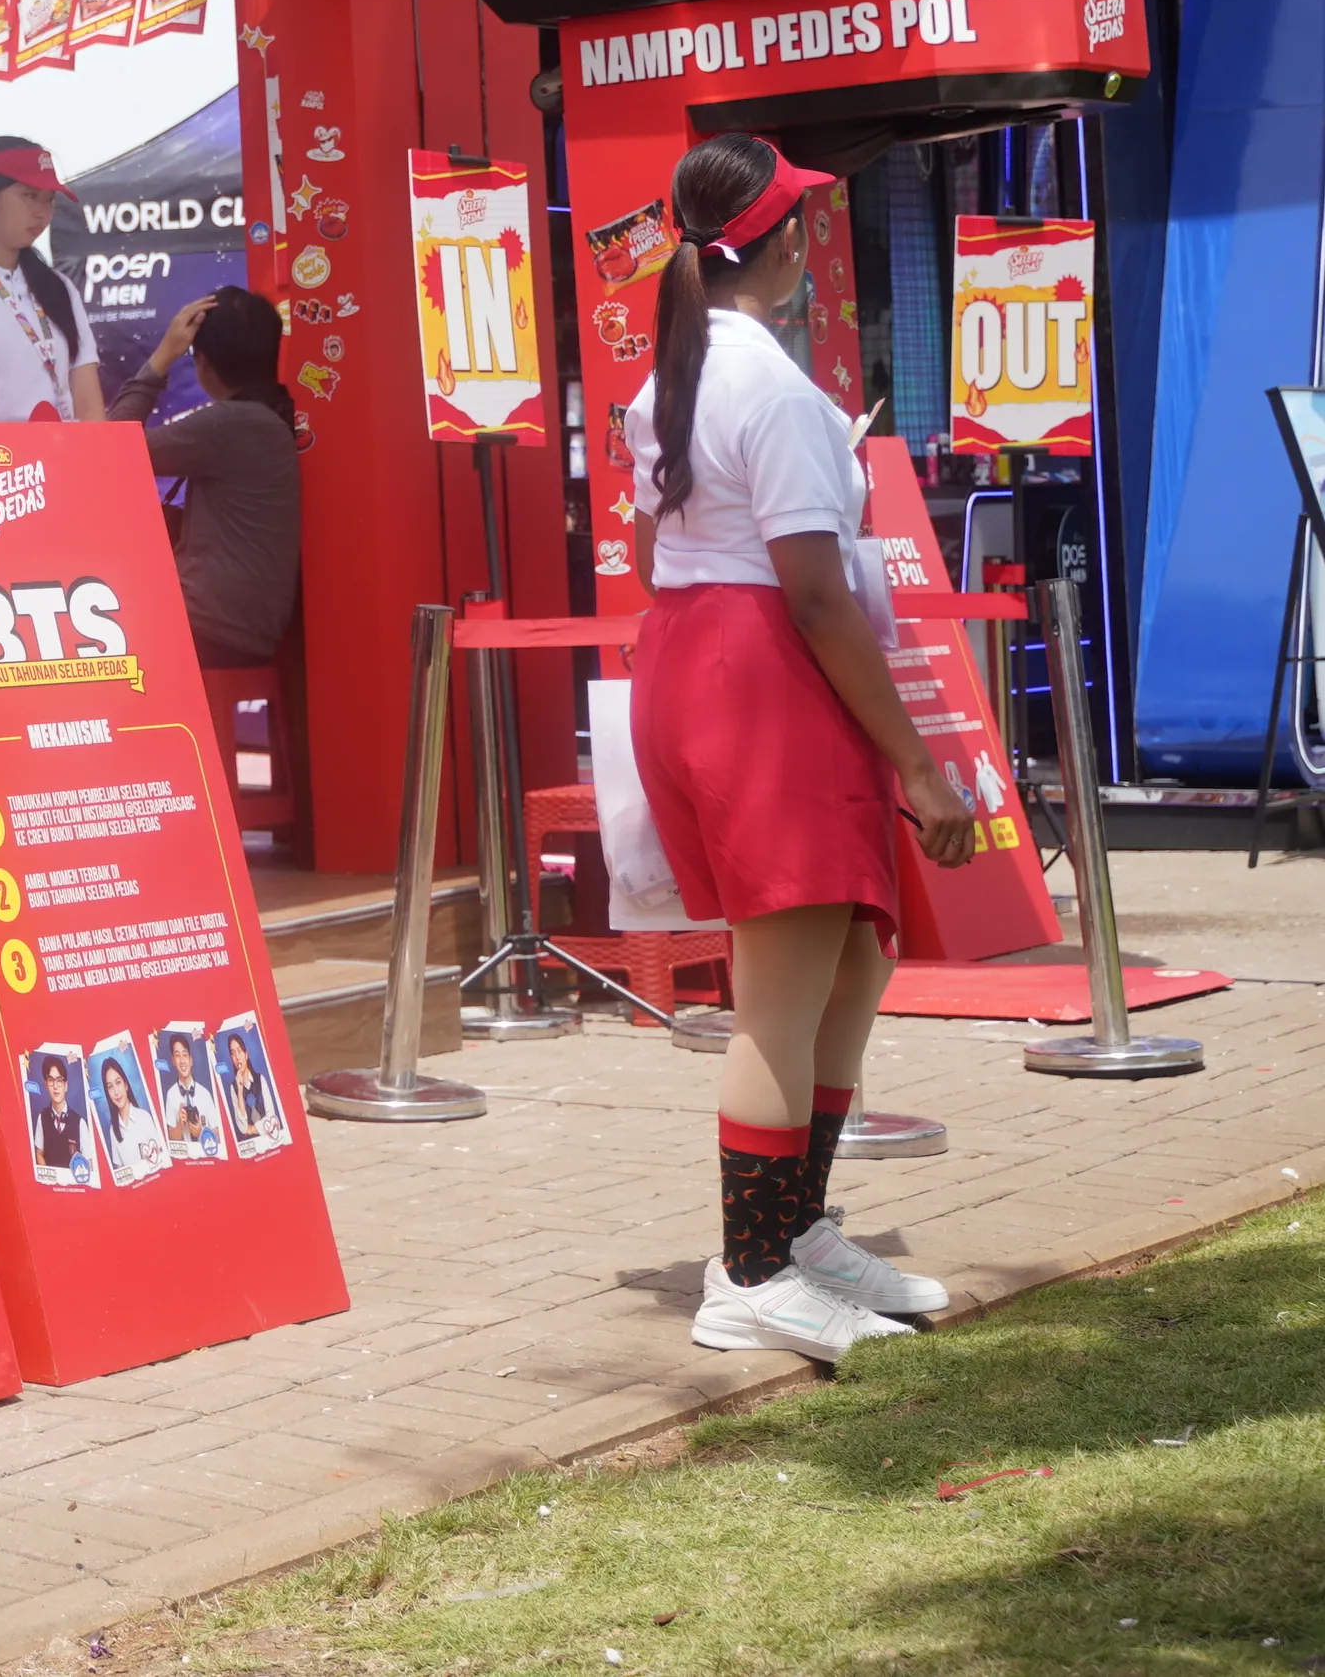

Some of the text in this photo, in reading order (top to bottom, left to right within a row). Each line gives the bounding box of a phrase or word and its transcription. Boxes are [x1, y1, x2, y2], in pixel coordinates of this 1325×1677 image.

[580, 20, 744, 87] NAMPOL
[750, 1, 883, 67] PEDES
[1088, 15, 1124, 53] PEDAS
[83, 198, 204, 234] WORLD
[629, 230, 666, 260] NAMPOL
[84, 251, 171, 304] posn
[101, 283, 147, 307] MEN
[439, 244, 518, 372] IN
[960, 300, 1087, 391] OUT
[899, 563, 929, 586] POL
[9, 664, 58, 682] TAHUNAN
[58, 662, 96, 680] SELERA
[98, 660, 128, 677] PEDAS
[26, 719, 113, 750] MEKANISME
[52, 790, 78, 807] KUPON
[120, 783, 148, 800] SELERA
[147, 781, 172, 797] PEDAS
[27, 827, 50, 845] CREW
[49, 825, 74, 842] BUKU
[73, 821, 109, 840] TAHUNAN
[109, 819, 137, 836] SELERA
[136, 816, 161, 833] PEDAS
[29, 810, 52, 827] BUKTI
[52, 807, 82, 824] FOLLOW
[24, 872, 49, 890] AMBIL
[49, 869, 79, 887] MOMEN
[78, 865, 111, 883] TERBAIK
[28, 880, 139, 908] BUKU TAHUNAN SELERA PEDAS
[38, 935, 62, 953] BAWA
[61, 931, 92, 950] PULANG
[91, 928, 115, 946] HASIL
[114, 924, 139, 942] CETAK
[139, 921, 169, 939] FOTOMU
[184, 916, 200, 933] FILE
[200, 912, 228, 930] DIGITAL
[11, 951, 26, 982] 3
[42, 954, 65, 972] YANG
[63, 952, 84, 969] BISA
[83, 949, 106, 967] KAMU
[149, 937, 180, 957] JANGAN
[180, 936, 198, 953] LUPA
[196, 932, 225, 951] UPLOAD
[56, 973, 85, 991] SOCIAL
[84, 968, 110, 987] MEDIA
[211, 950, 229, 967] YAA!
